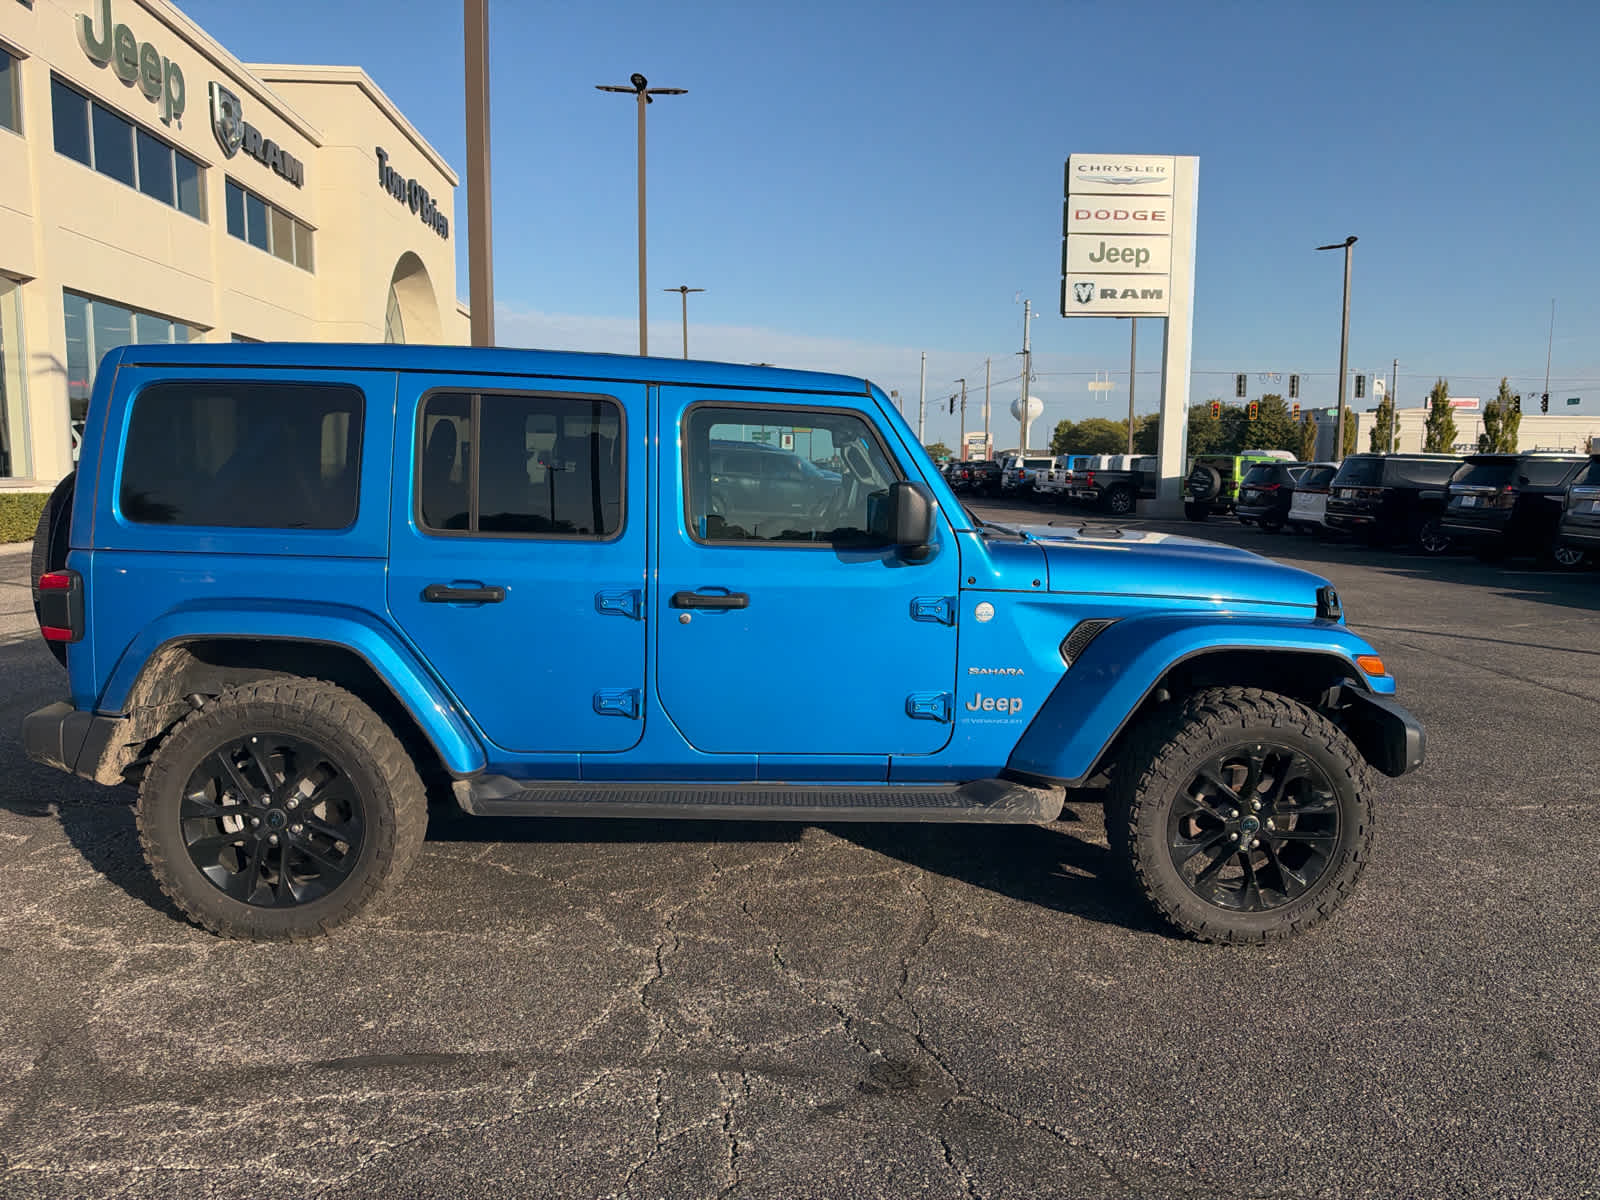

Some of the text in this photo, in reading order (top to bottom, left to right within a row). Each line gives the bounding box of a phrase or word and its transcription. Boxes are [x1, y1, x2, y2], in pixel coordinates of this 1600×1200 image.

[76, 0, 186, 123] Jeep
[242, 121, 304, 190] RAM
[376, 146, 406, 206] Tom
[1077, 164, 1166, 173] CHRYSLER
[1075, 209, 1167, 222] DODGE
[1088, 241, 1150, 268] Jeep
[1100, 288, 1163, 300] RAM
[968, 667, 1025, 677] SAHARA
[966, 692, 1023, 715] Jeep
